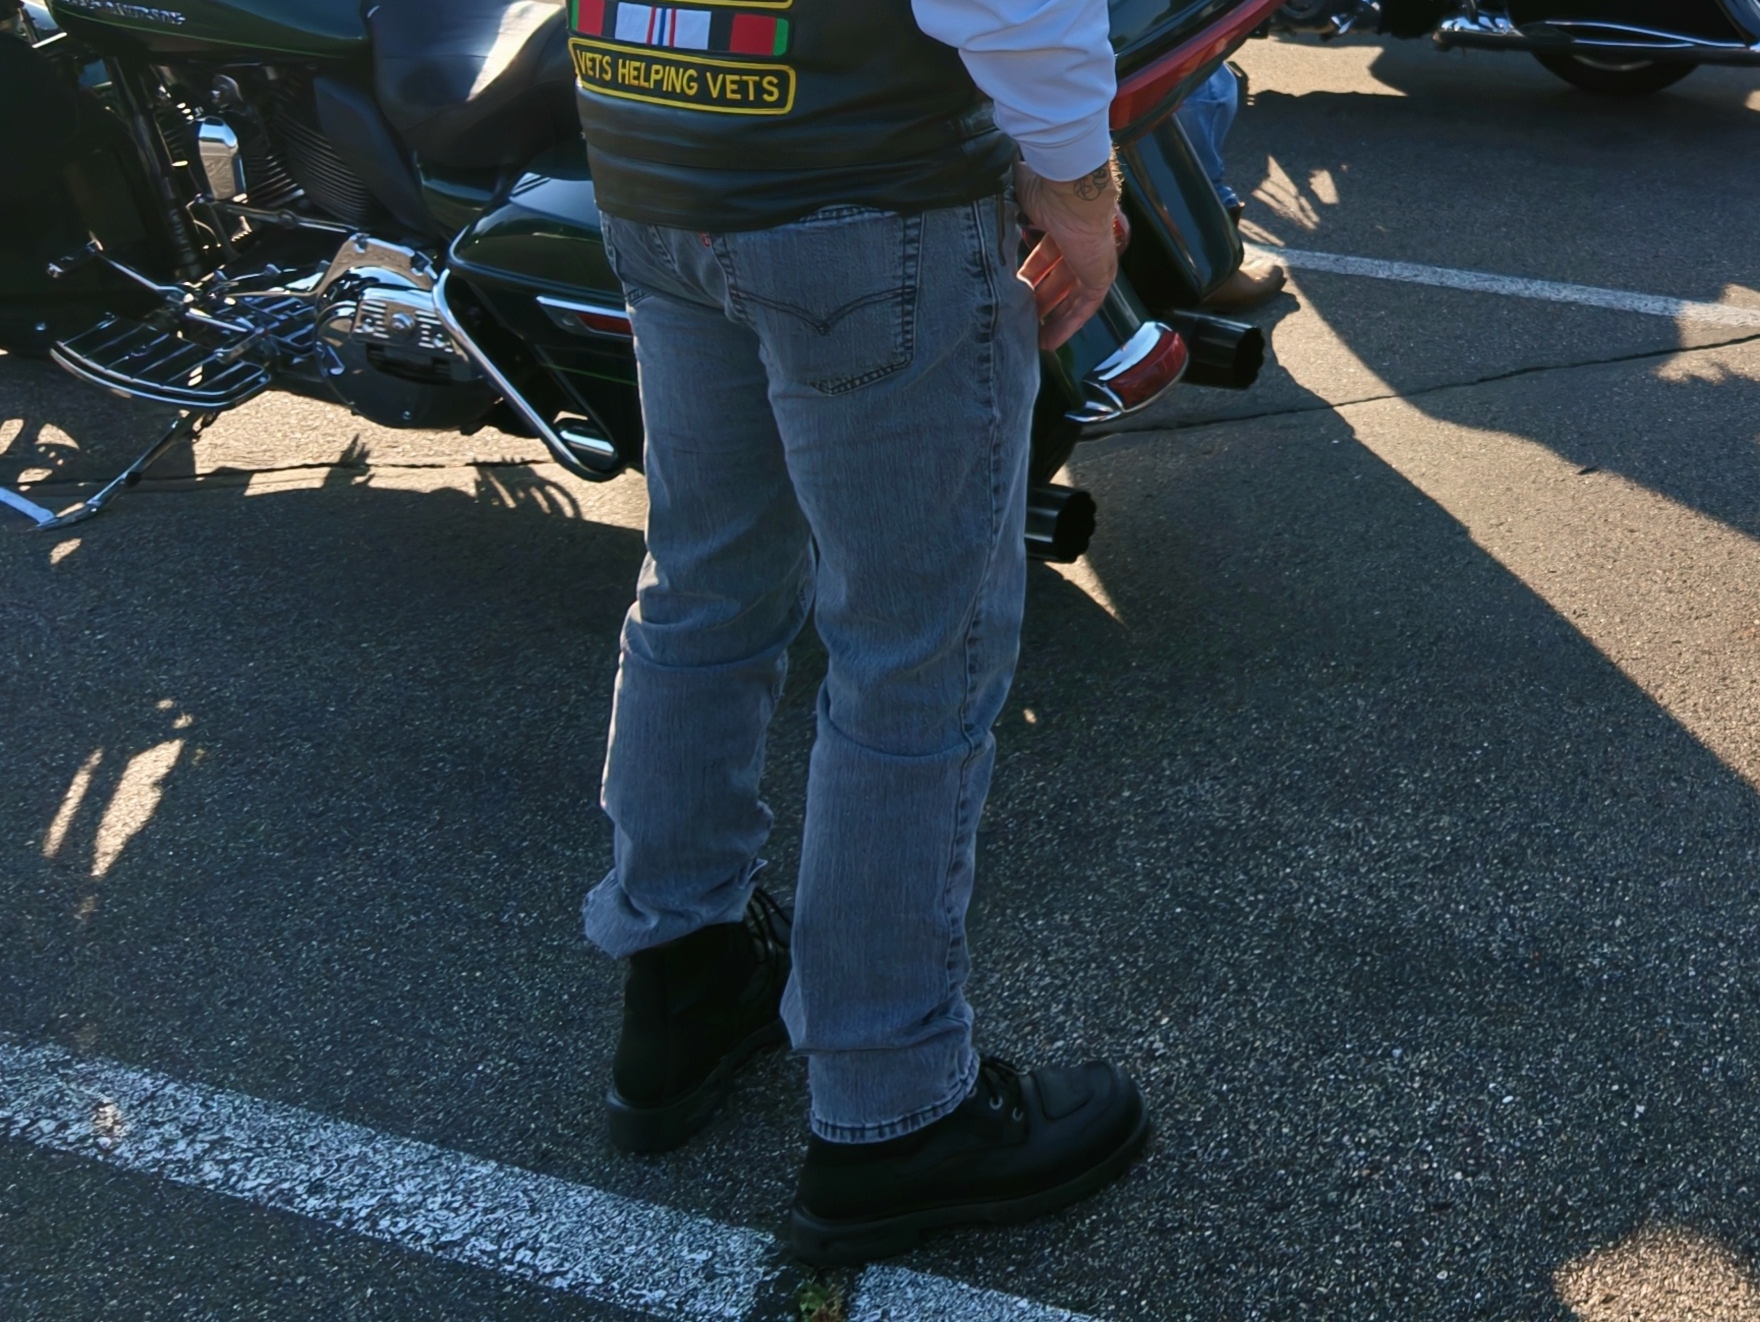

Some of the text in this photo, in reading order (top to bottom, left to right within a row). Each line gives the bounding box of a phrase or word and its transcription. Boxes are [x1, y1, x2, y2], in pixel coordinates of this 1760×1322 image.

[576, 49, 780, 103] VETS HELPING VETS
